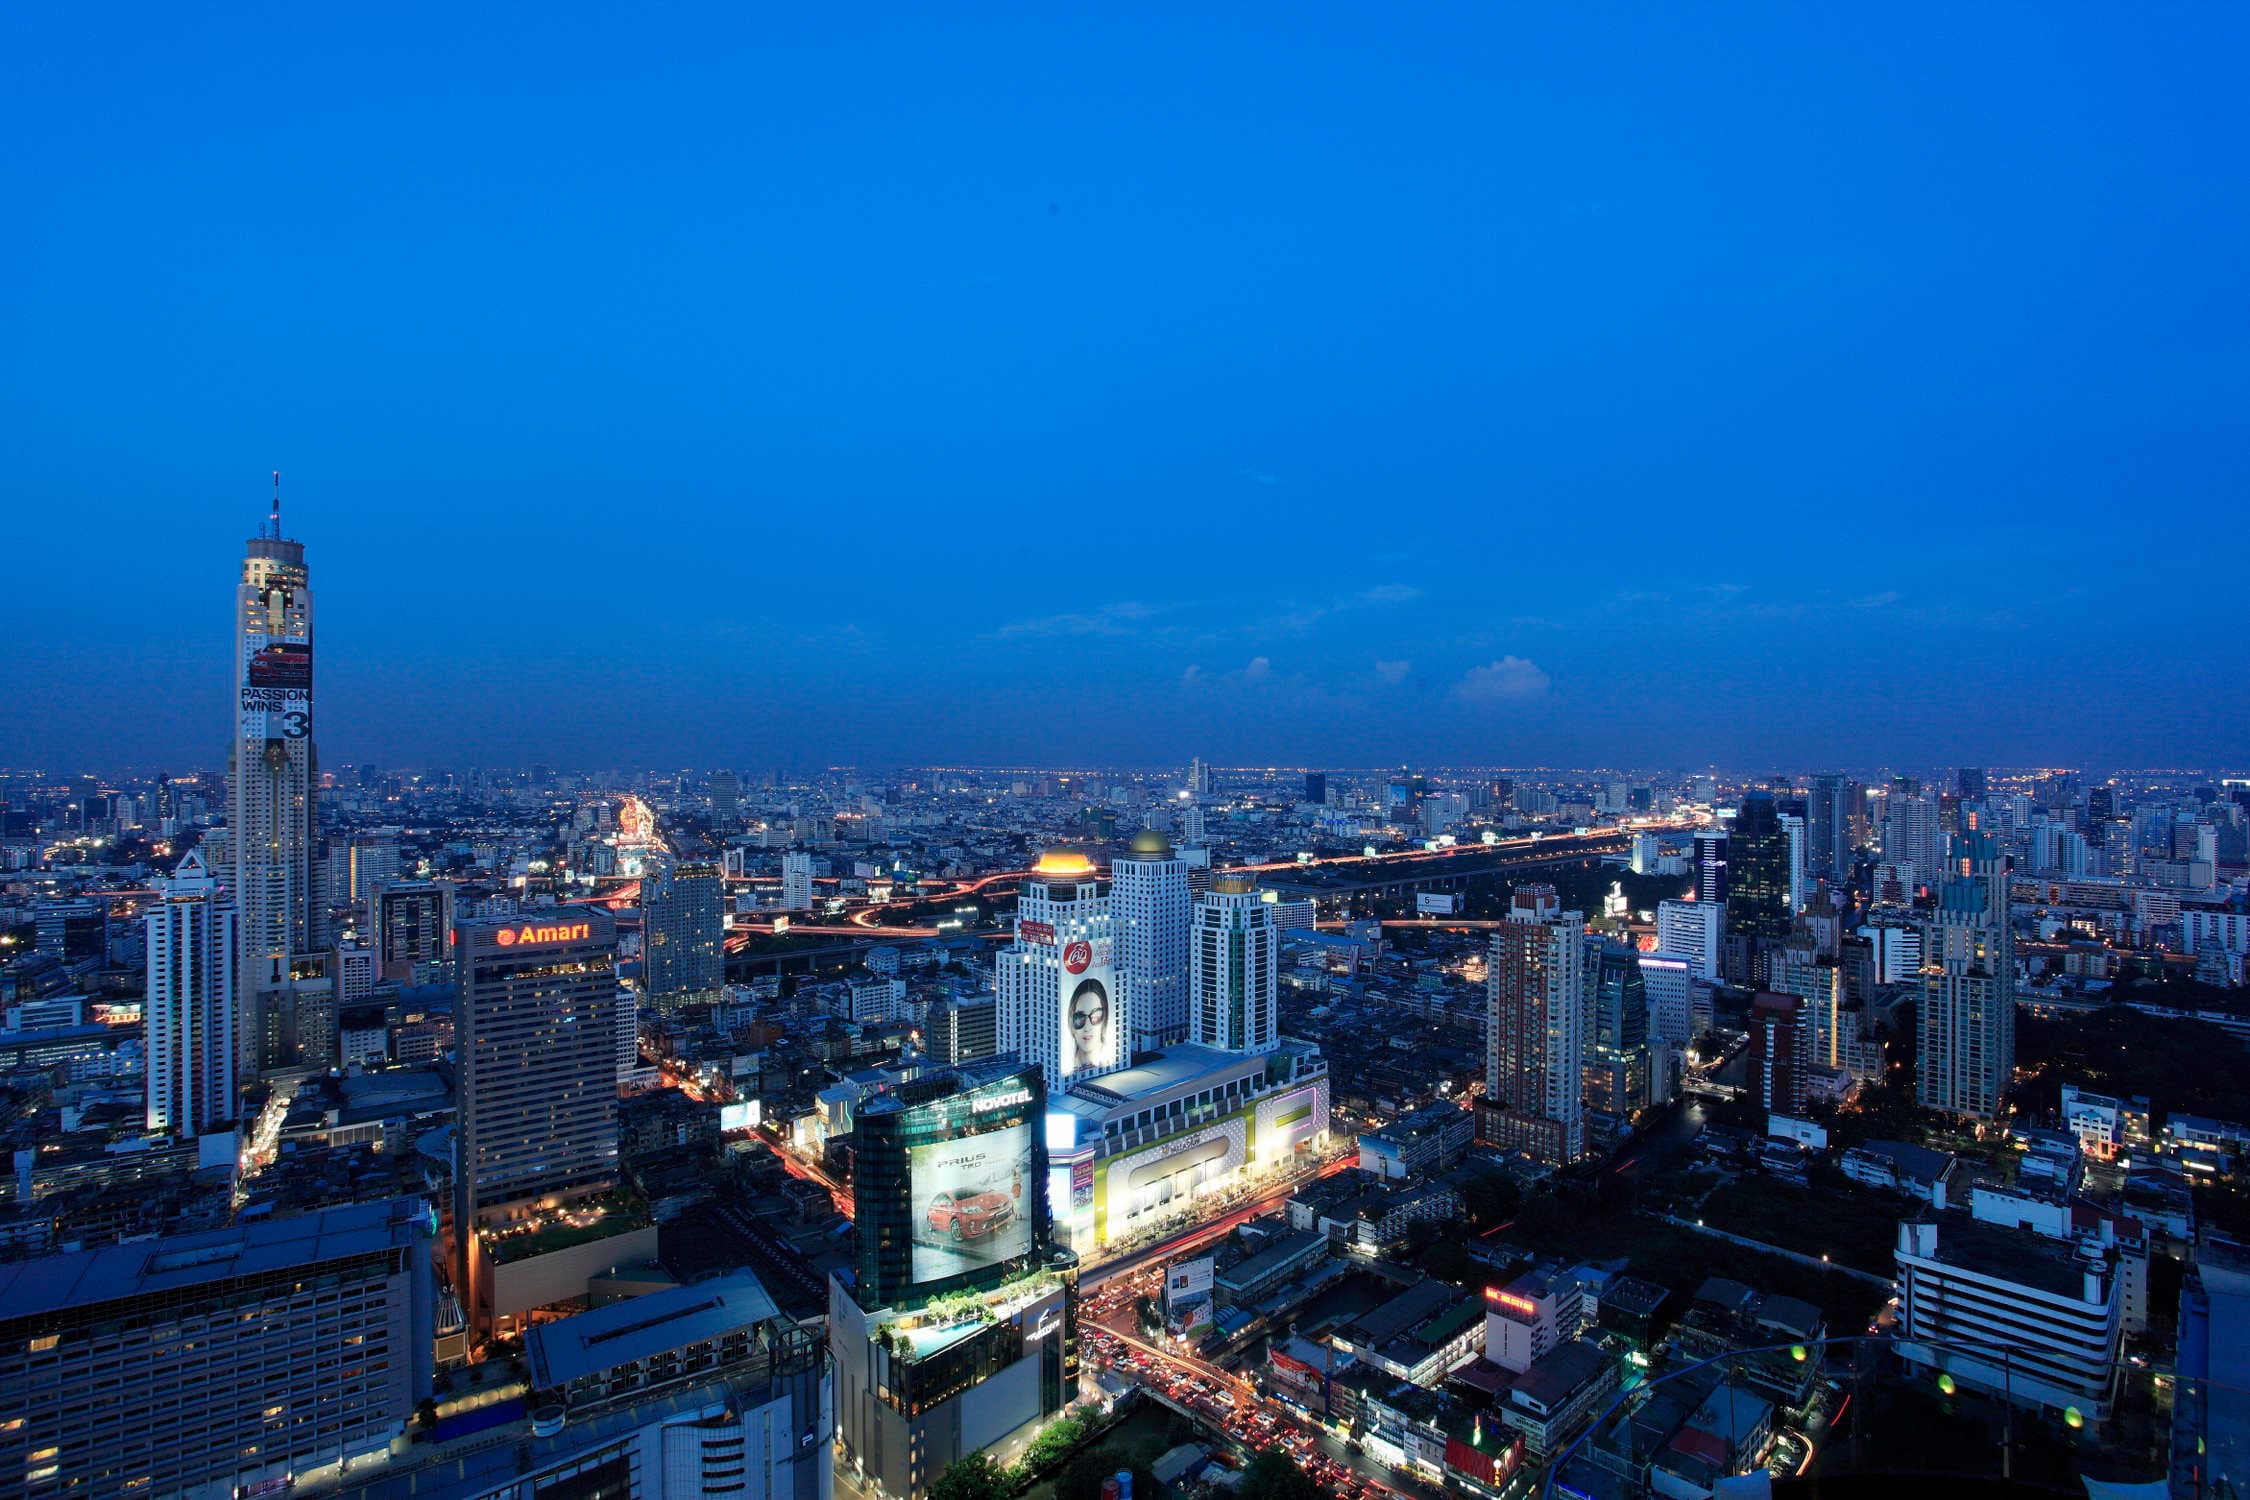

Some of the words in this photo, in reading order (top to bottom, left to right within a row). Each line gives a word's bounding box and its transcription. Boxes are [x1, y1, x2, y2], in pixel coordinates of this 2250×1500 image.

[241, 688, 311, 700] PASSION
[241, 700, 286, 712] WINS.
[283, 711, 308, 738] 3
[518, 924, 589, 944] Amari
[972, 1089, 1032, 1113] NOVOTEL
[937, 1153, 986, 1168] PRIUS
